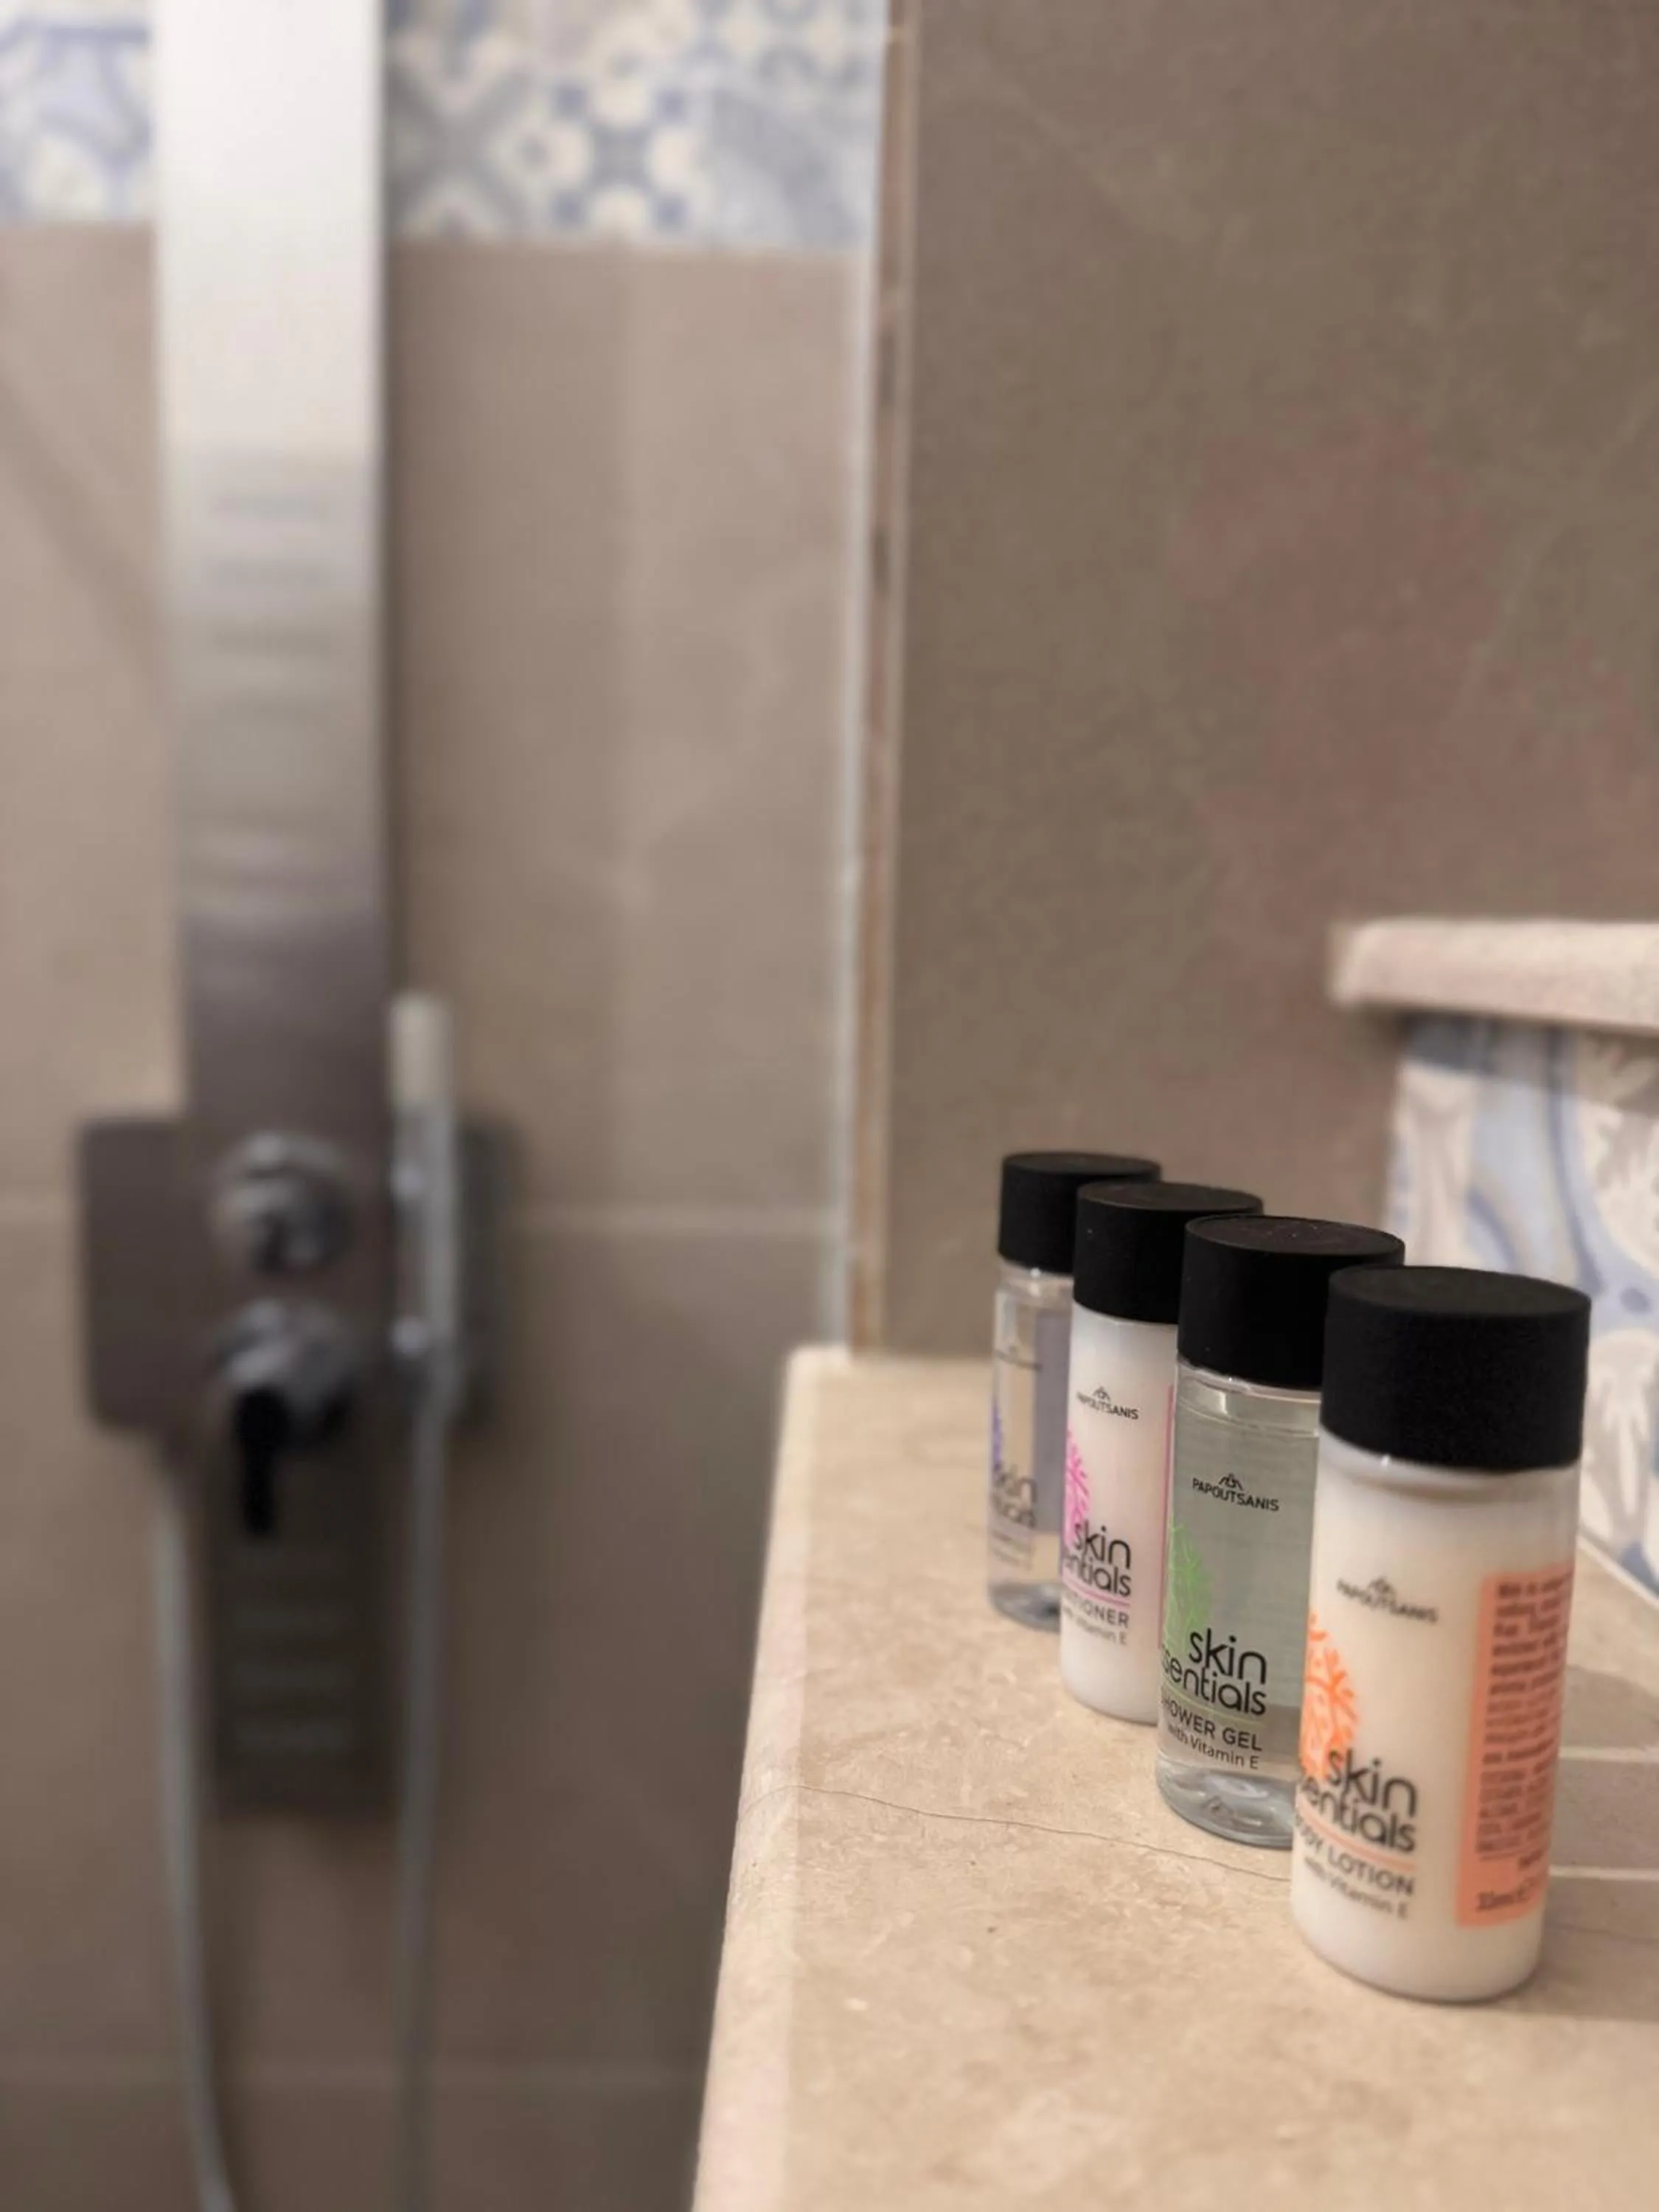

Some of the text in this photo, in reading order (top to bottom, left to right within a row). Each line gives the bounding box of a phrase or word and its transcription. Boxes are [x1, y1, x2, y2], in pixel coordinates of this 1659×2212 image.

[1192, 1476, 1281, 1512] PAPOUTSANIS
[1074, 1519, 1131, 1570] skin
[1065, 1552, 1131, 1598] entials
[1161, 1644, 1267, 1717] sentials
[1189, 1627, 1267, 1686] skin
[1189, 1733, 1245, 1768] Vitamin
[1249, 1755, 1260, 1770] E
[1222, 1727, 1263, 1753] GEL
[1327, 1747, 1418, 1818] skin
[1300, 1775, 1417, 1854] entials
[1326, 1845, 1414, 1896] LOTION
